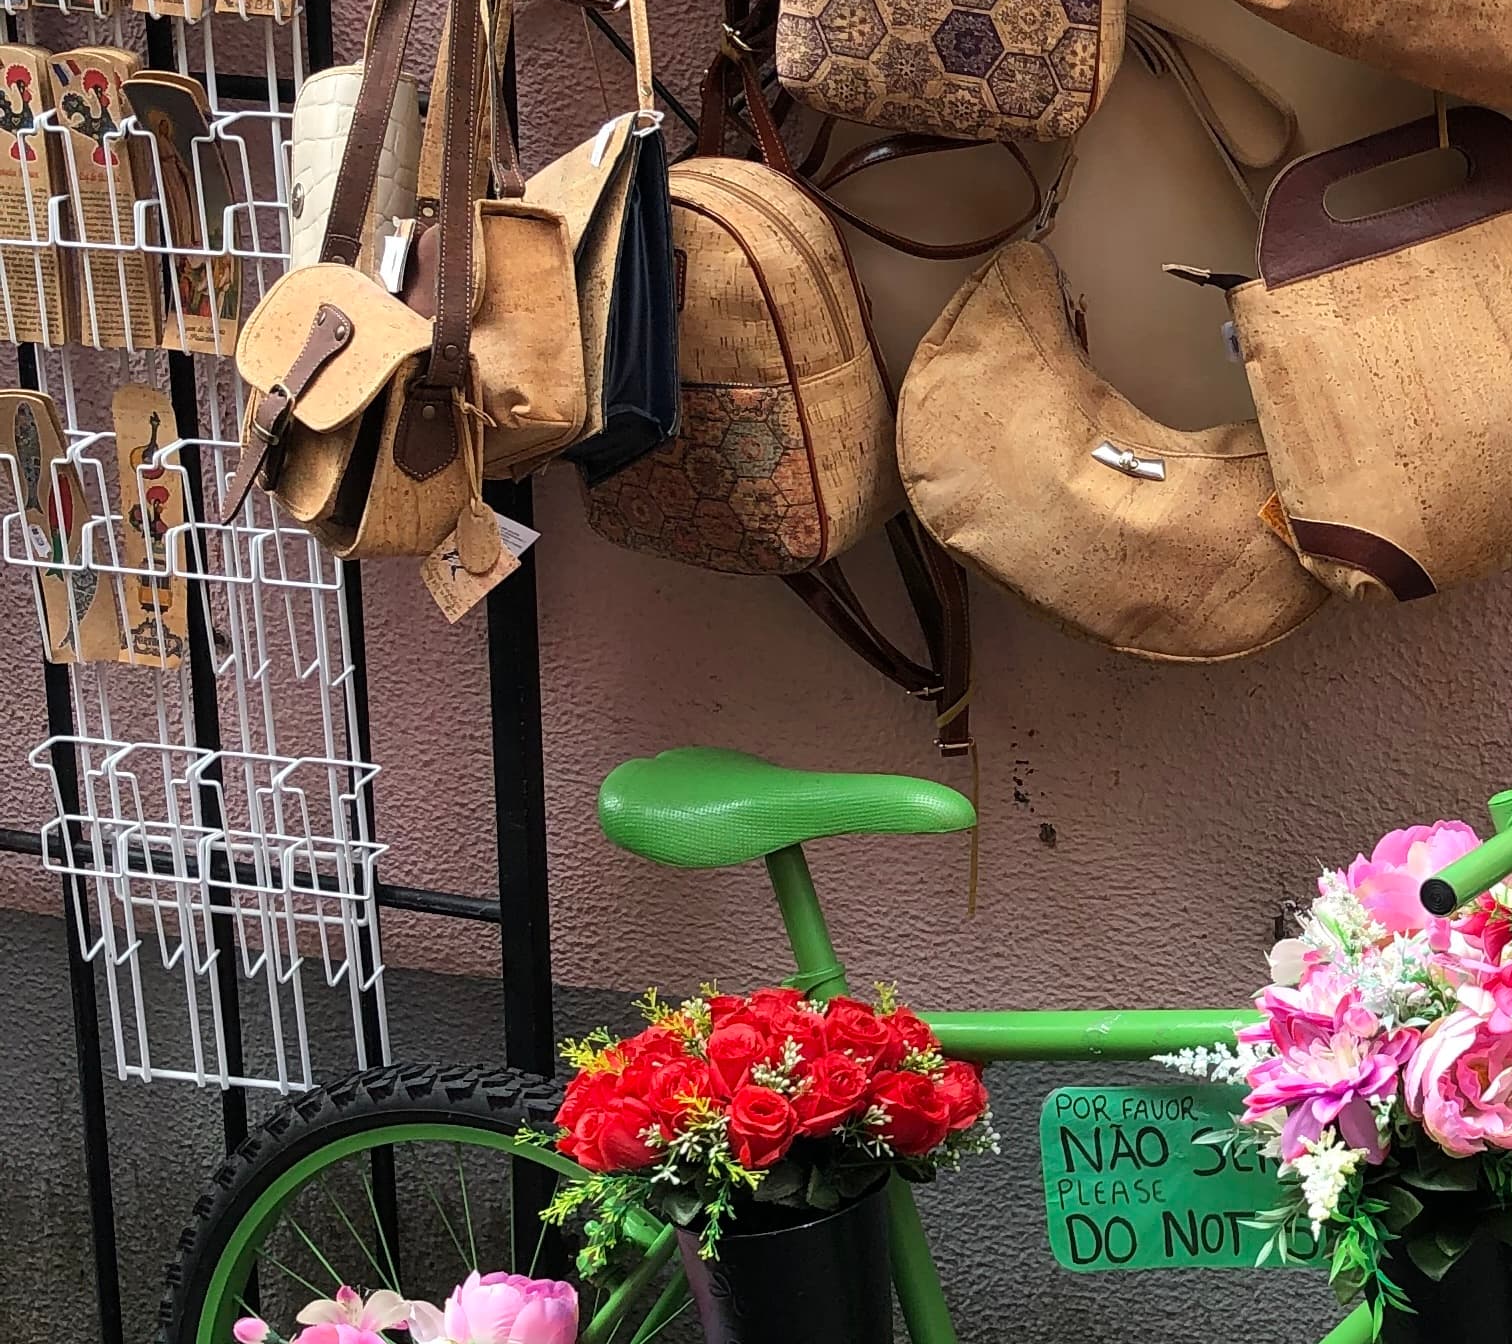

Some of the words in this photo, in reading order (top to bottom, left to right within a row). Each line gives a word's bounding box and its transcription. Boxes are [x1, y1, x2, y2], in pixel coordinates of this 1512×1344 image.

[1056, 1093, 1110, 1121] POR
[1122, 1096, 1199, 1121] FAVOR
[1060, 1123, 1169, 1173] NÃO
[1057, 1178, 1166, 1210] PLEASE
[1065, 1213, 1137, 1265] DO
[1162, 1208, 1256, 1258] NOT
